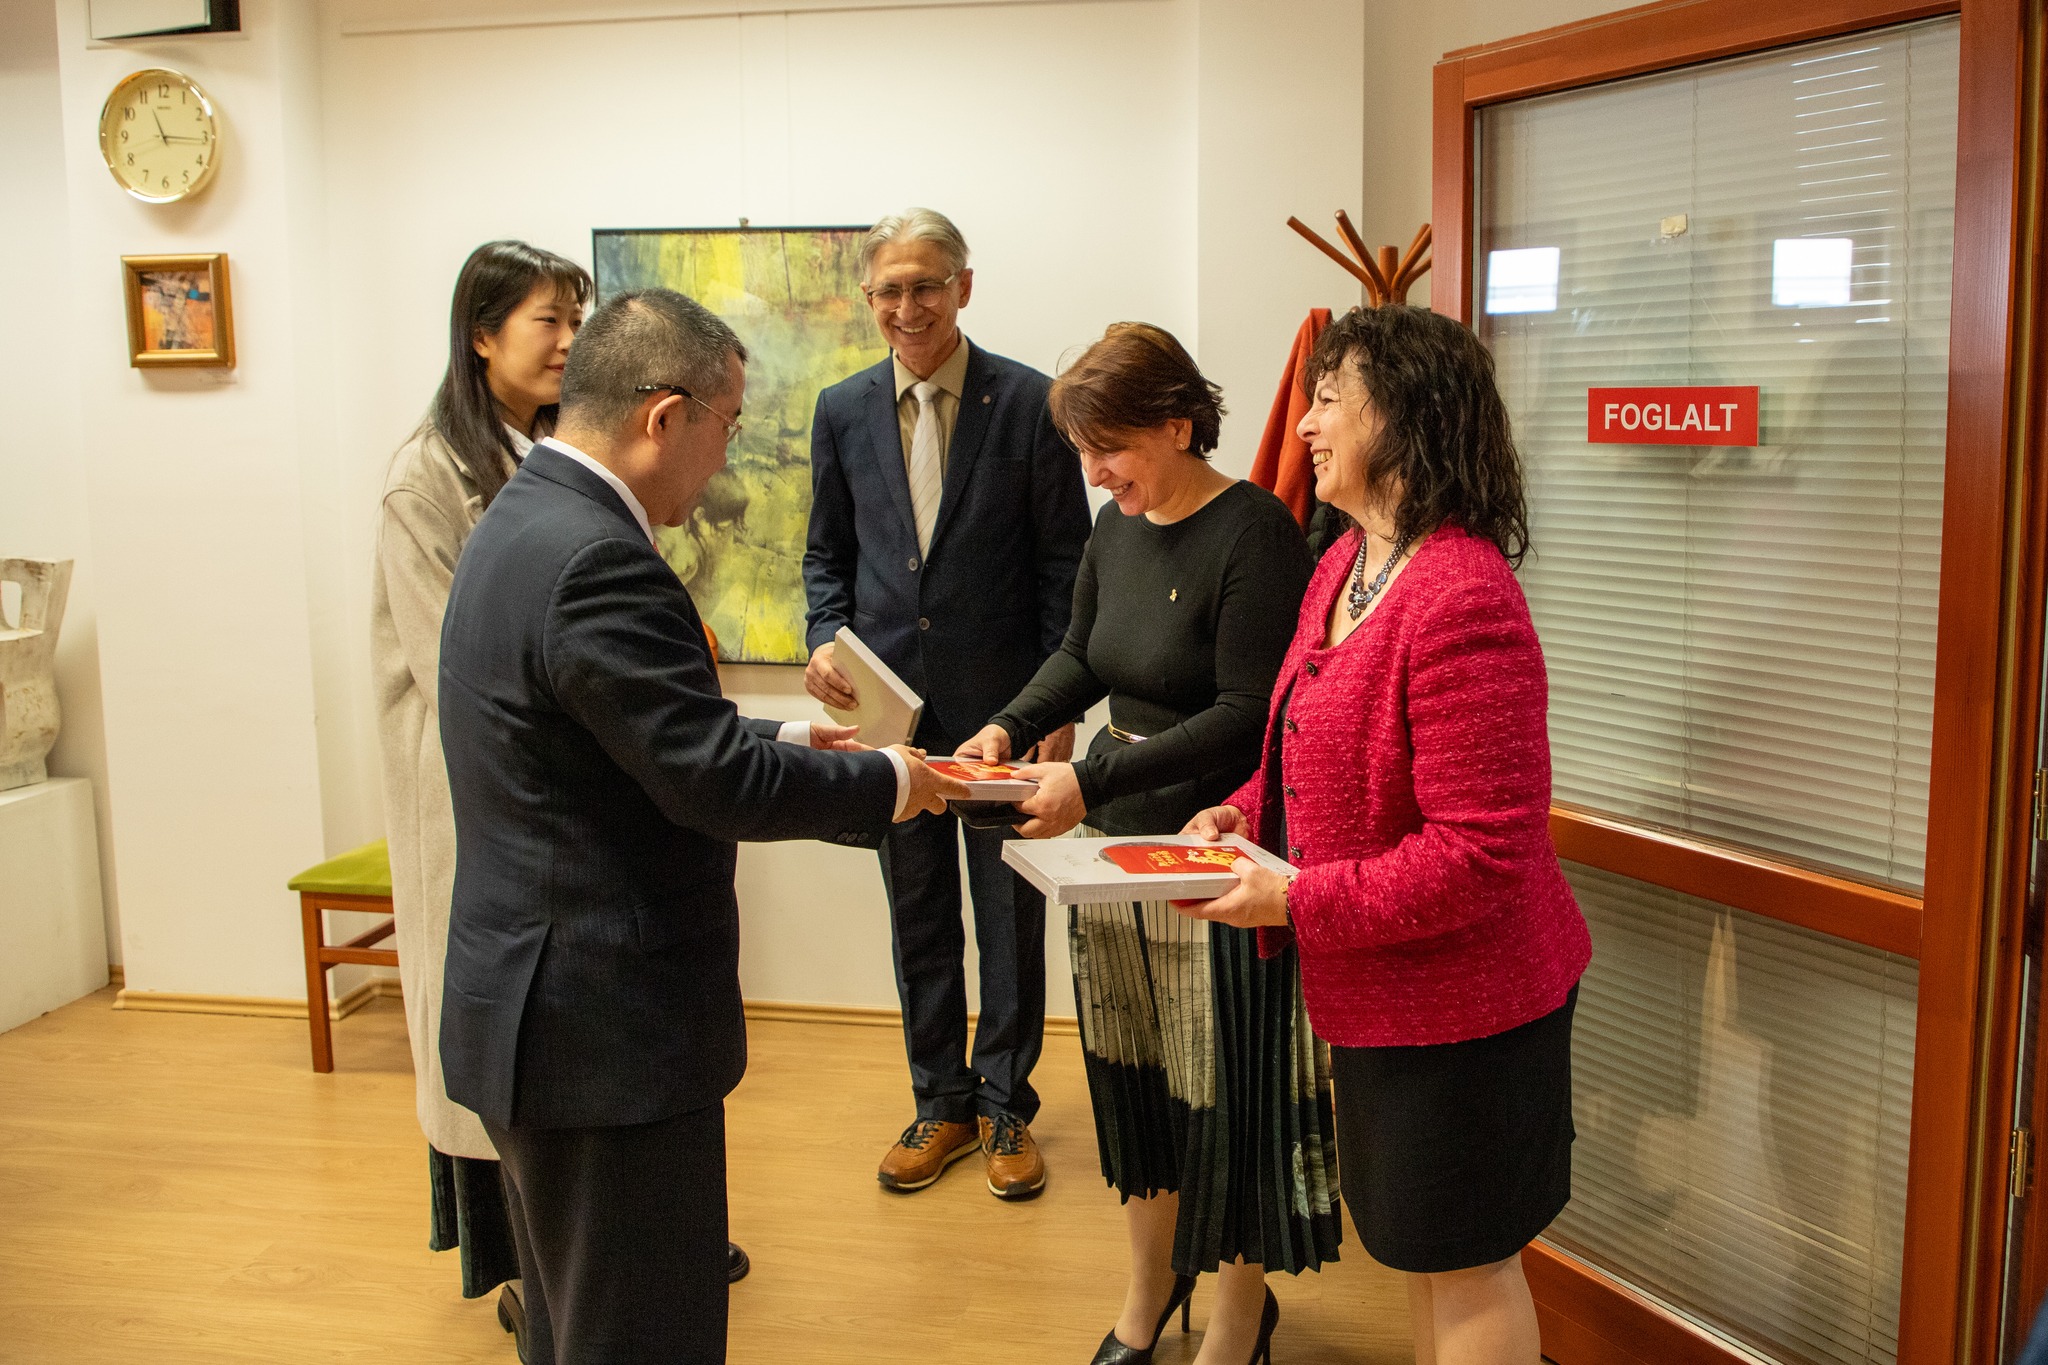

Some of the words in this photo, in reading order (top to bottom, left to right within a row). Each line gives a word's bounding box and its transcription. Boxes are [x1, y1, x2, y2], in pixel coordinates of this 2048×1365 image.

[140, 90, 148, 104] 11
[158, 84, 170, 98] 12
[124, 107, 136, 121] 10
[196, 107, 203, 121] 2
[121, 130, 129, 144] 9
[202, 130, 209, 145] 3
[127, 152, 135, 166] 8
[196, 154, 203, 166] 4
[142, 169, 149, 182] 7
[161, 176, 169, 189] 6
[182, 170, 189, 183] 5
[1604, 403, 1738, 432] FOGLALT
